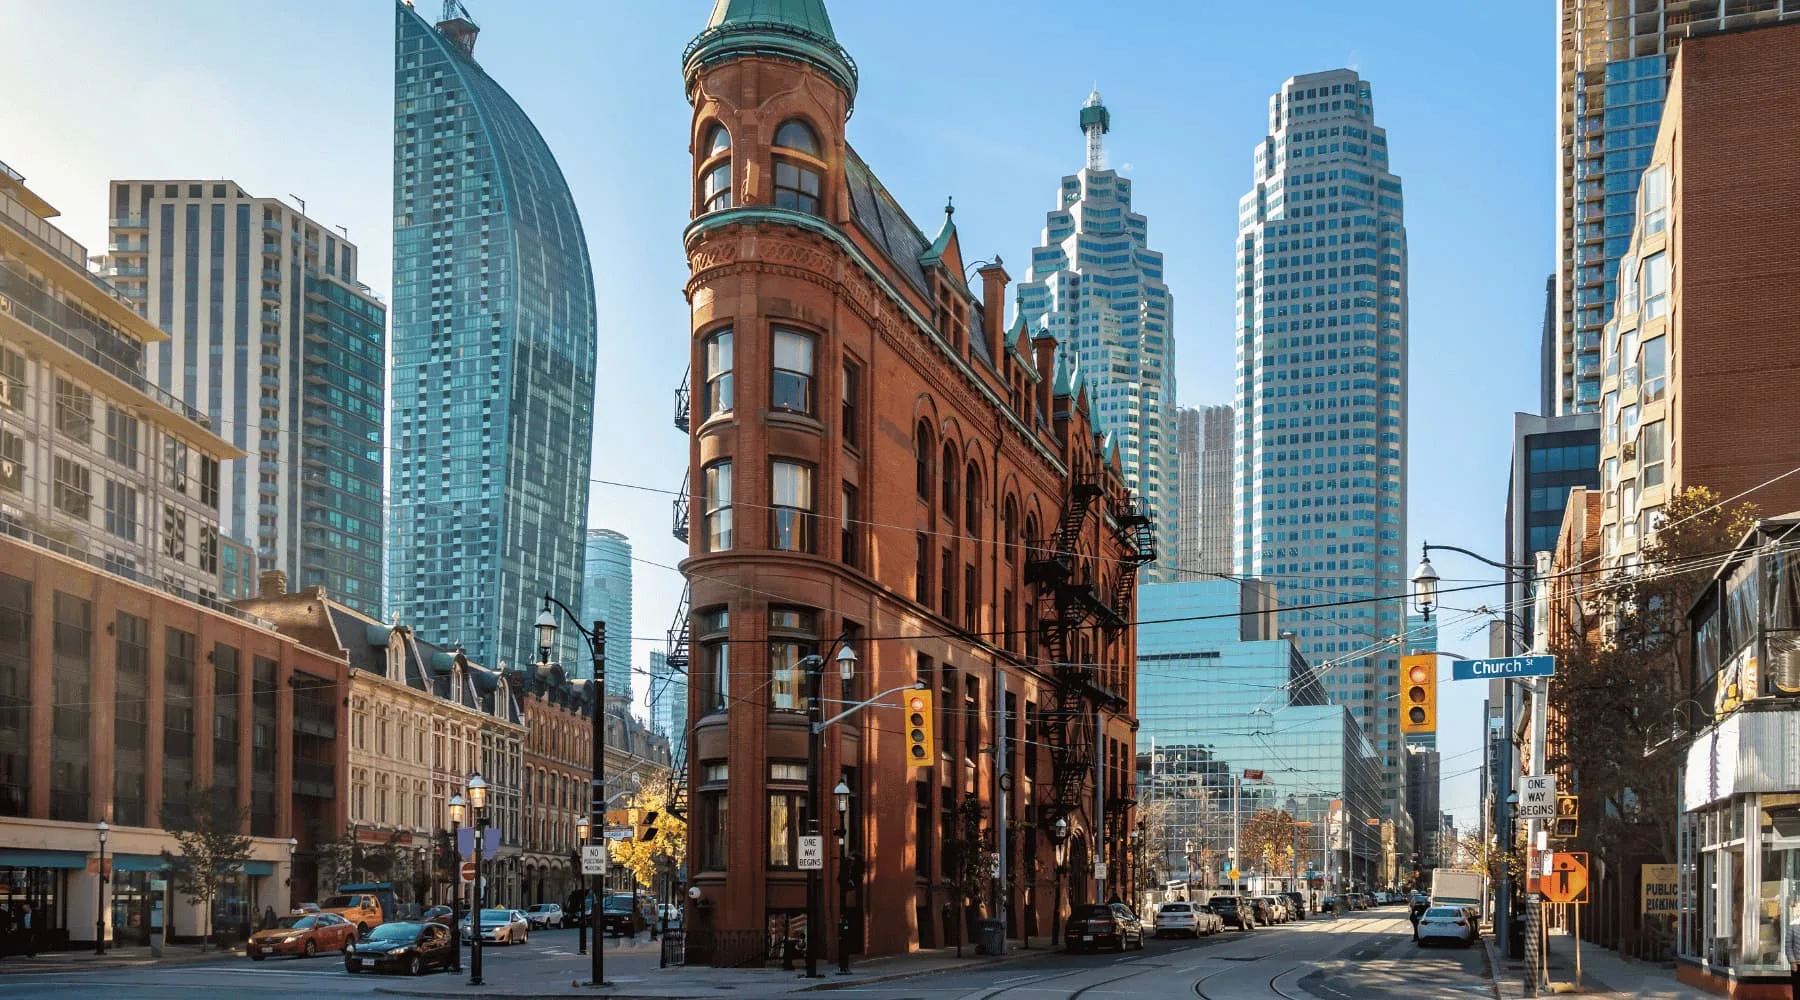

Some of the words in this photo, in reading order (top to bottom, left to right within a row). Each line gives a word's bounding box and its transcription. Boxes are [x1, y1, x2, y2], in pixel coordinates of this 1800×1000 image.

[1472, 659, 1522, 675] Church
[1525, 658, 1534, 666] St
[1527, 778, 1547, 789] ONE
[1527, 791, 1546, 802] WAY
[1520, 804, 1554, 816] BEGINS
[803, 838, 817, 847] ONE
[590, 848, 599, 857] NO
[804, 848, 816, 857] WAY
[799, 858, 821, 866] BEGINS
[1646, 883, 1678, 896] PUBLIC
